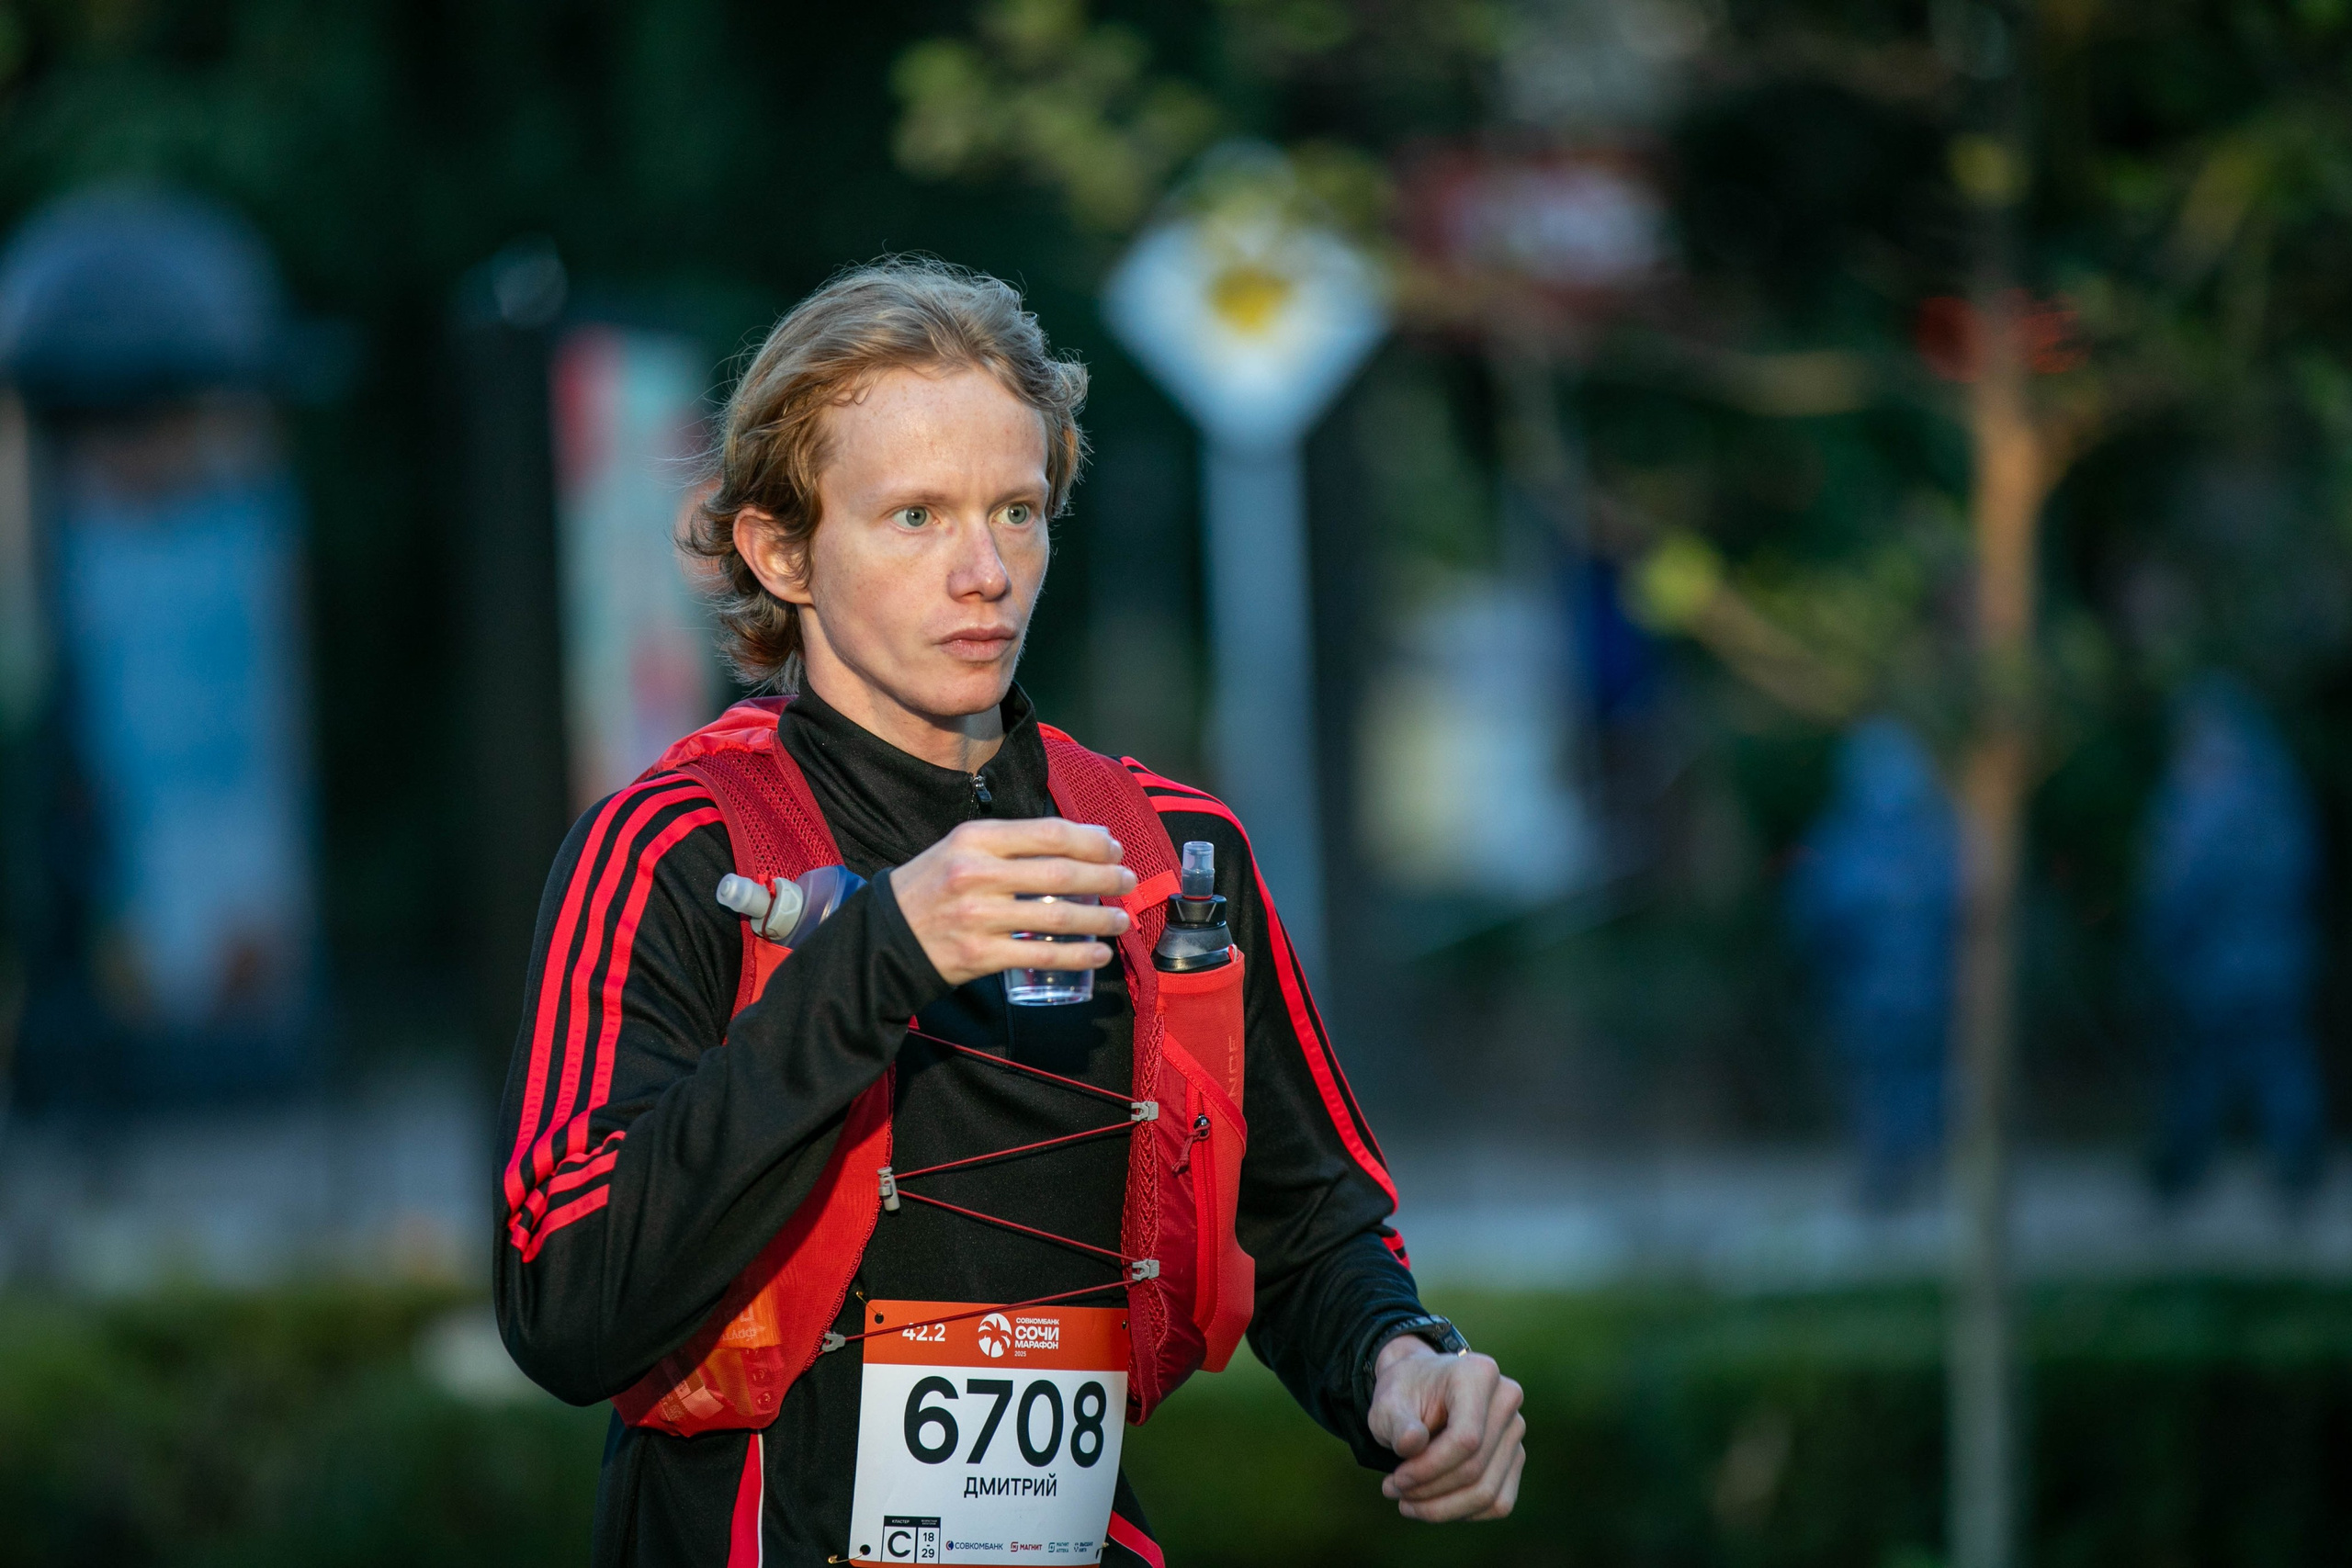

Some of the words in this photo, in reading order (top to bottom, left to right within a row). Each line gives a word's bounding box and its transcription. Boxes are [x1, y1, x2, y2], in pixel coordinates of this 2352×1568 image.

[1015, 1317, 1060, 1325] СОВКОМБАНК
[902, 1323, 945, 1342] 42.2
[1014, 1325, 1059, 1341] СОЧИ
[1014, 1340, 1058, 1349] МАРАФОН
[903, 1375, 1107, 1469] 6708
[964, 1473, 1057, 1499] ДМИТРИЙ
[922, 1532, 934, 1542] 18
[955, 1542, 1003, 1551] СОВКОМБАНК
[922, 1548, 935, 1559] 29
